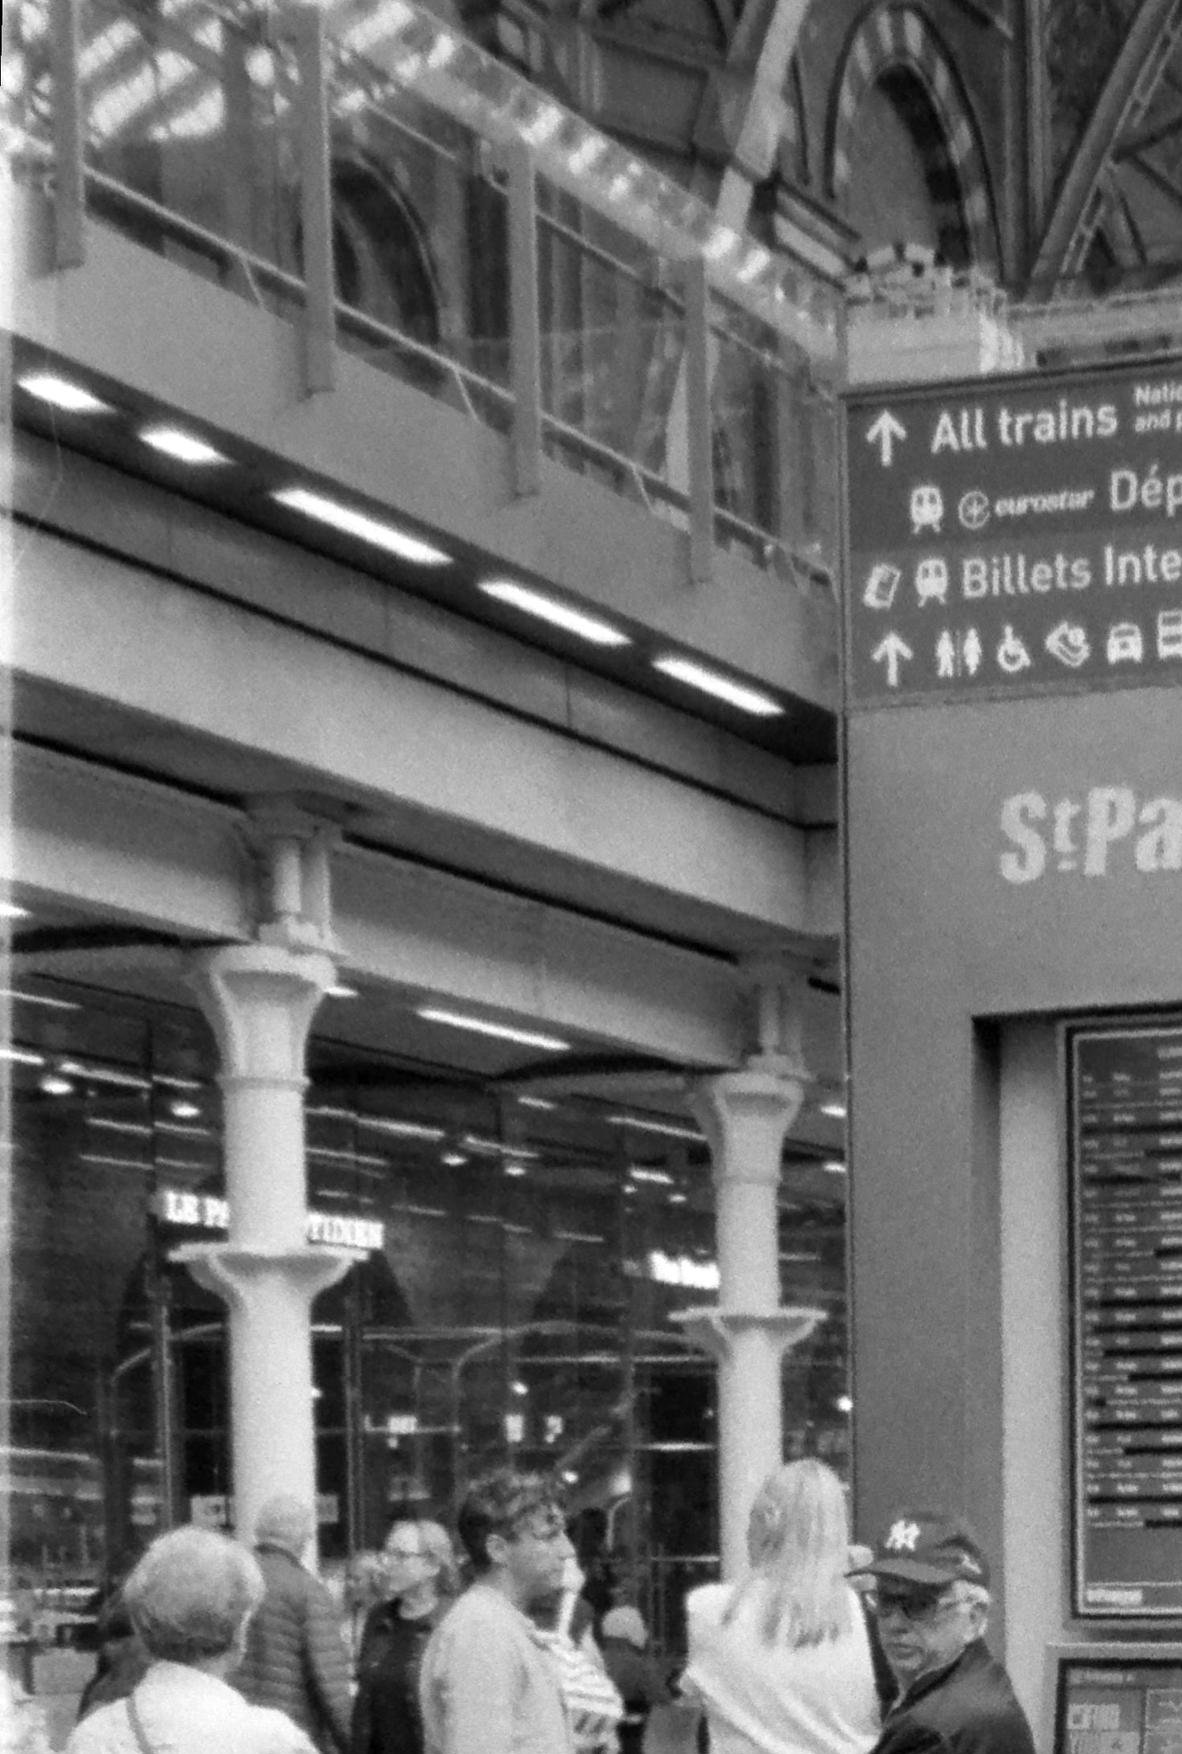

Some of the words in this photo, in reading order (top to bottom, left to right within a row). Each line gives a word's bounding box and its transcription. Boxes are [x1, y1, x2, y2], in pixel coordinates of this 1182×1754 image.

[931, 407, 987, 454] All
[998, 401, 1118, 447] trains
[1134, 408, 1171, 432] and
[994, 488, 1095, 517] eurostar
[961, 552, 1091, 599] Billets
